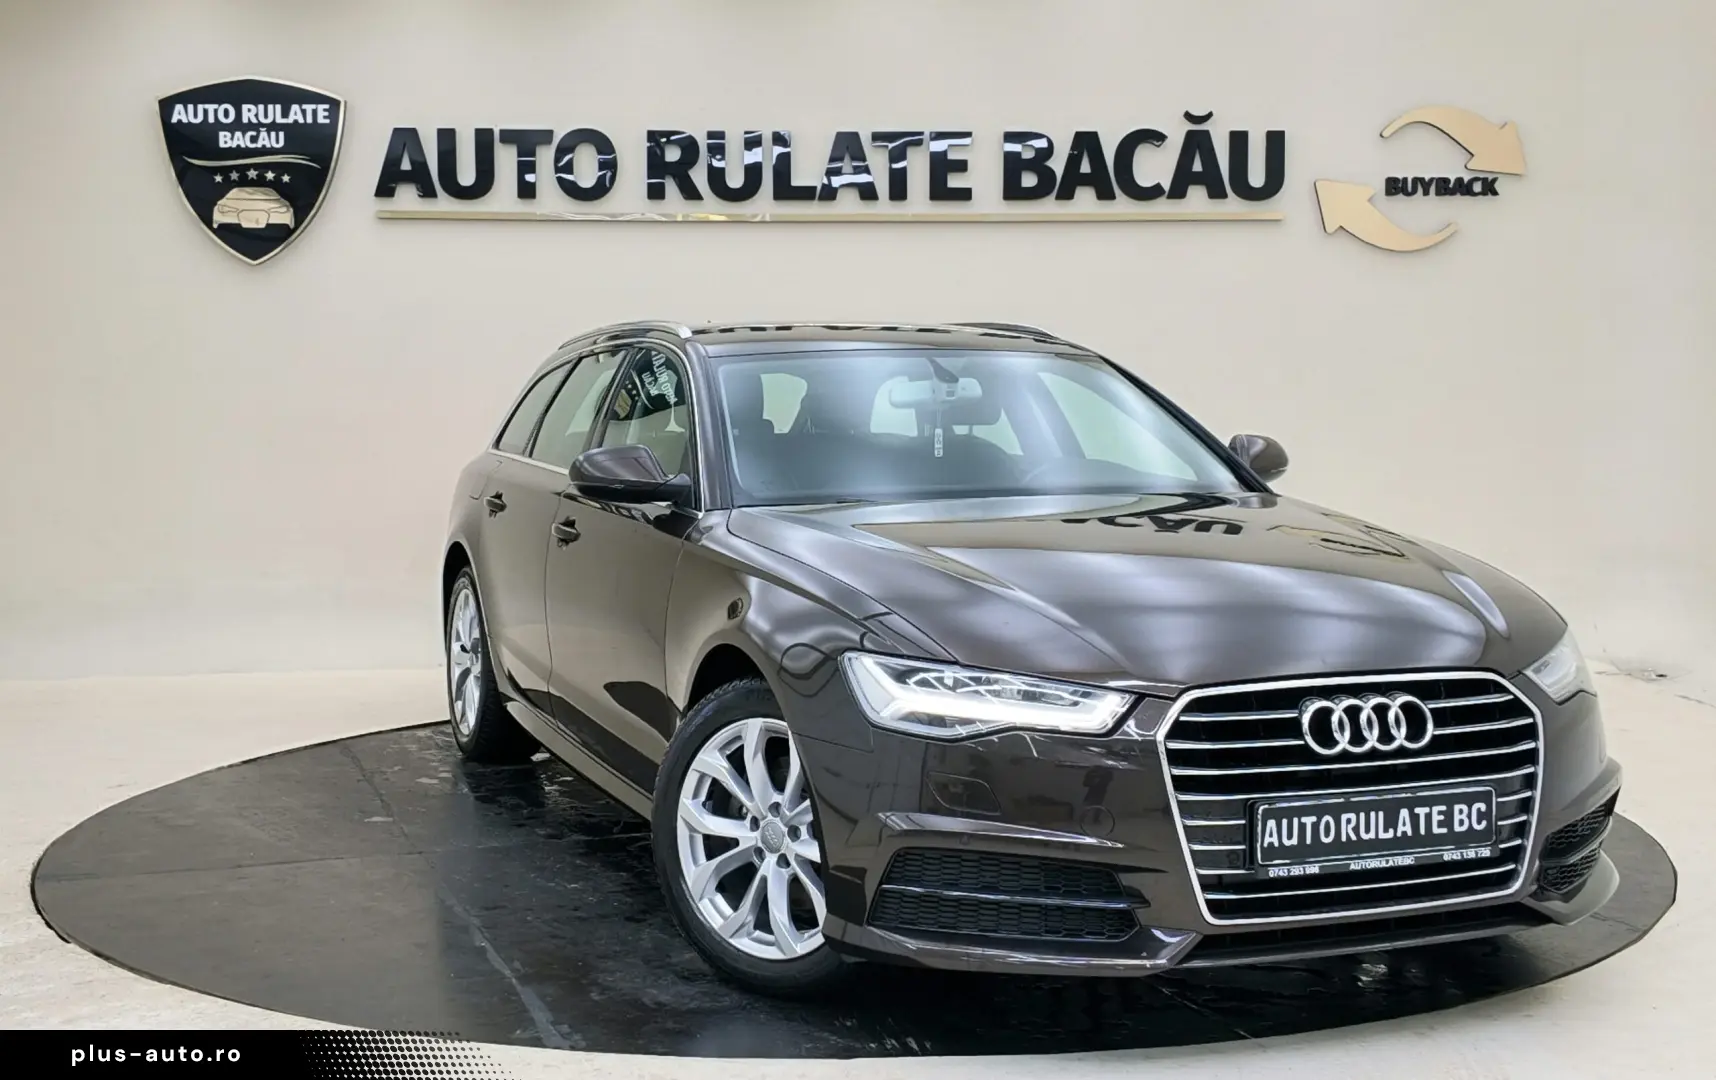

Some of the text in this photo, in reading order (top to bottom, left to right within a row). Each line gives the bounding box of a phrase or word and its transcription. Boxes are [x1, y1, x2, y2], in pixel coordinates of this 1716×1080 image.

[171, 103, 331, 124] AUTO RULATE
[218, 127, 285, 148] BACĂU
[374, 110, 1286, 202] AUTO RULATE BACĂU
[1384, 176, 1500, 197] BUYBACK
[1263, 802, 1488, 848] AUTO RULATE BC
[1349, 856, 1416, 870] AUTORULATEBC
